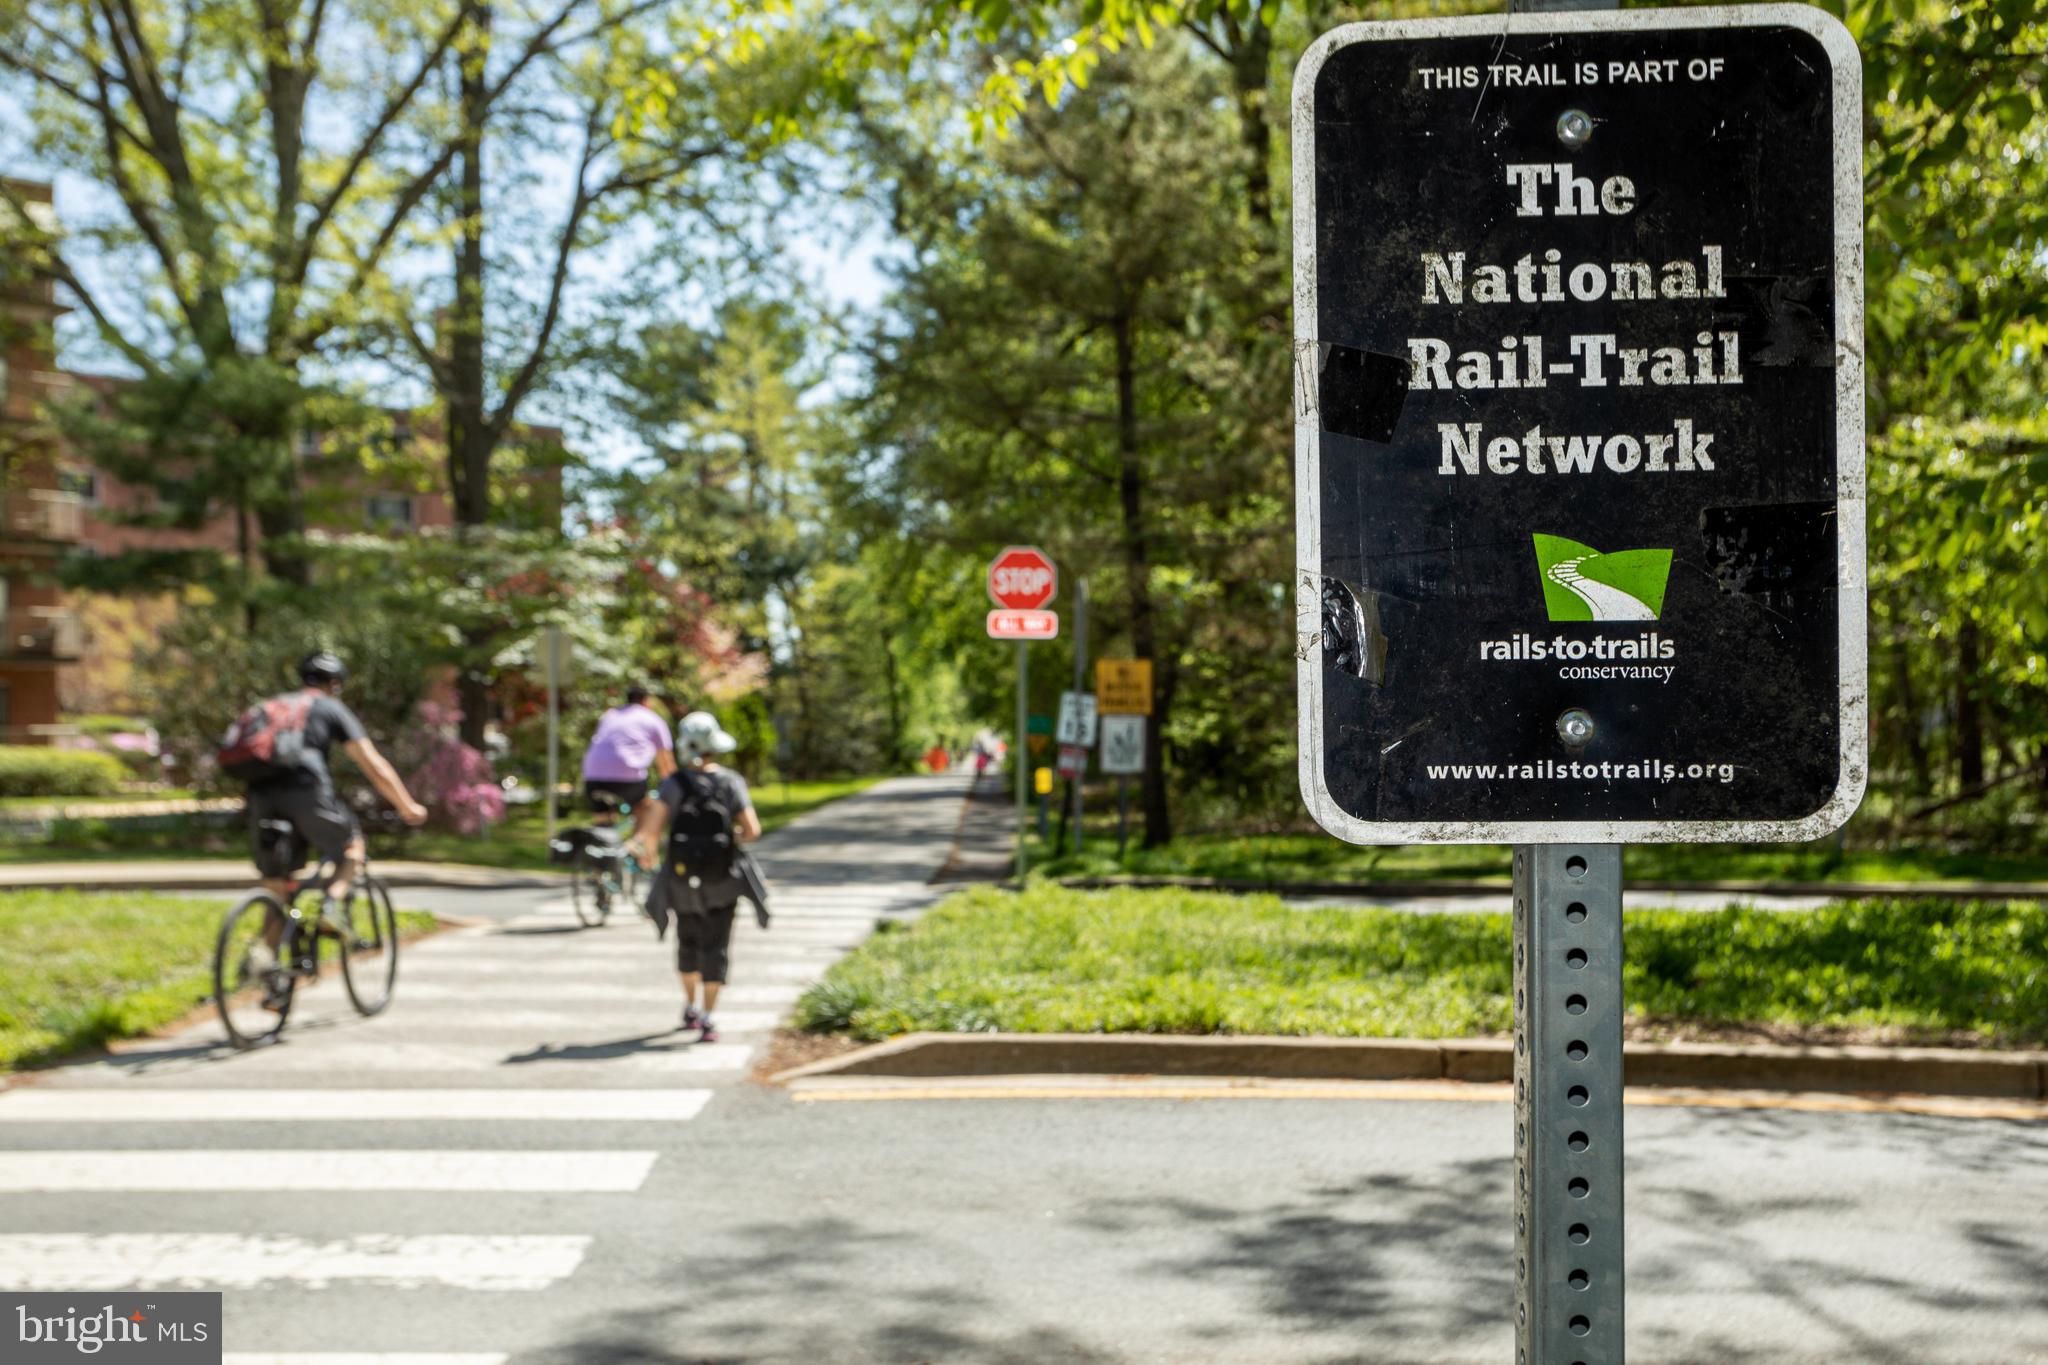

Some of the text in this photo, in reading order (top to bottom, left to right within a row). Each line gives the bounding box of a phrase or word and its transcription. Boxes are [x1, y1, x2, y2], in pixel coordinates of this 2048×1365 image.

[1419, 58, 1725, 90] THIS TRAIL IS PART OF
[1506, 163, 1637, 216] The
[1421, 245, 1727, 304] National
[1407, 331, 1744, 390] Rail-Trail
[1438, 418, 1715, 475] Network
[995, 568, 1050, 595] STOP
[1559, 664, 1675, 684] conservancy
[1427, 759, 1734, 783] www.railstotrails.org
